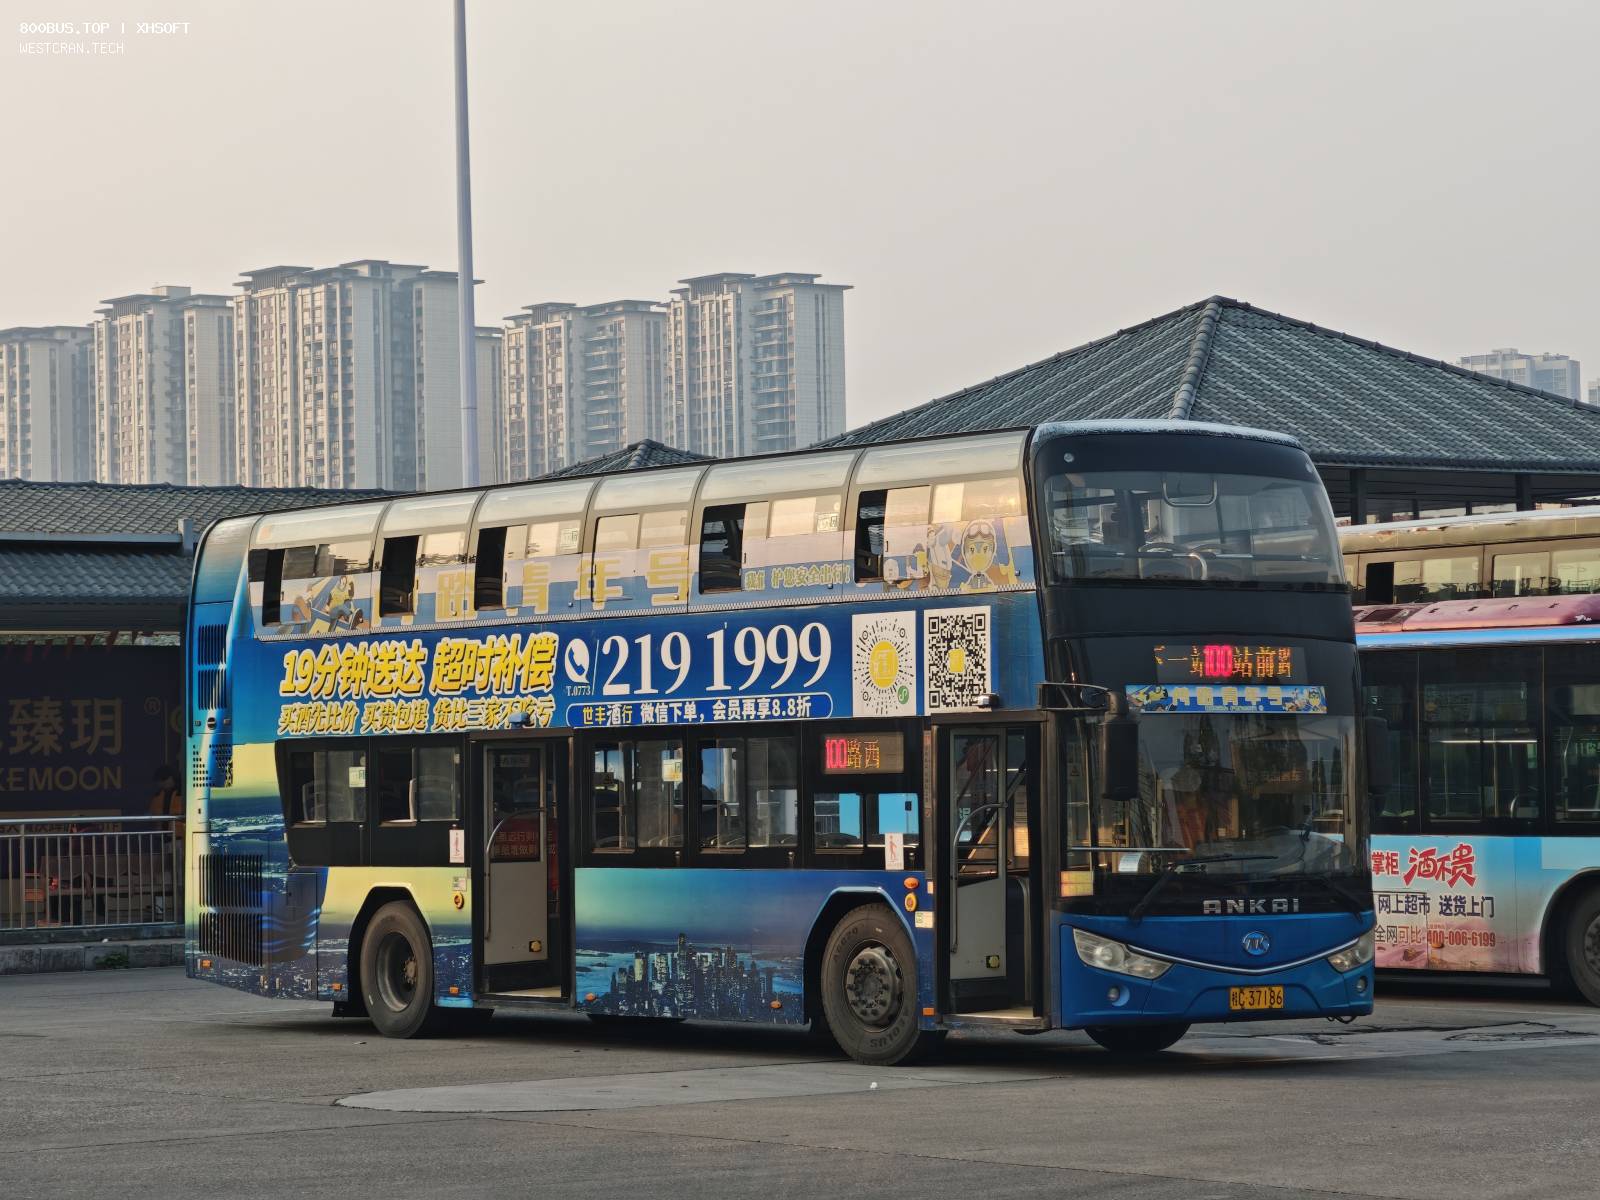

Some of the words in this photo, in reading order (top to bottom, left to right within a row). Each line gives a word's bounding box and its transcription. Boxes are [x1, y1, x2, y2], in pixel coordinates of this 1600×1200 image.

[280, 639, 428, 699] 19分钟送达
[429, 632, 559, 696] 超时补偿
[602, 631, 691, 695] 219
[706, 622, 832, 692] 1999
[277, 700, 360, 735] 买酒先比价
[360, 698, 430, 734] 买贵包退
[1403, 842, 1478, 888] 酒不贵
[1202, 898, 1300, 914] ANKAI
[1378, 893, 1431, 916] 网上超市
[1438, 894, 1495, 919] 送货上门
[1427, 929, 1497, 948] 400-006-6199
